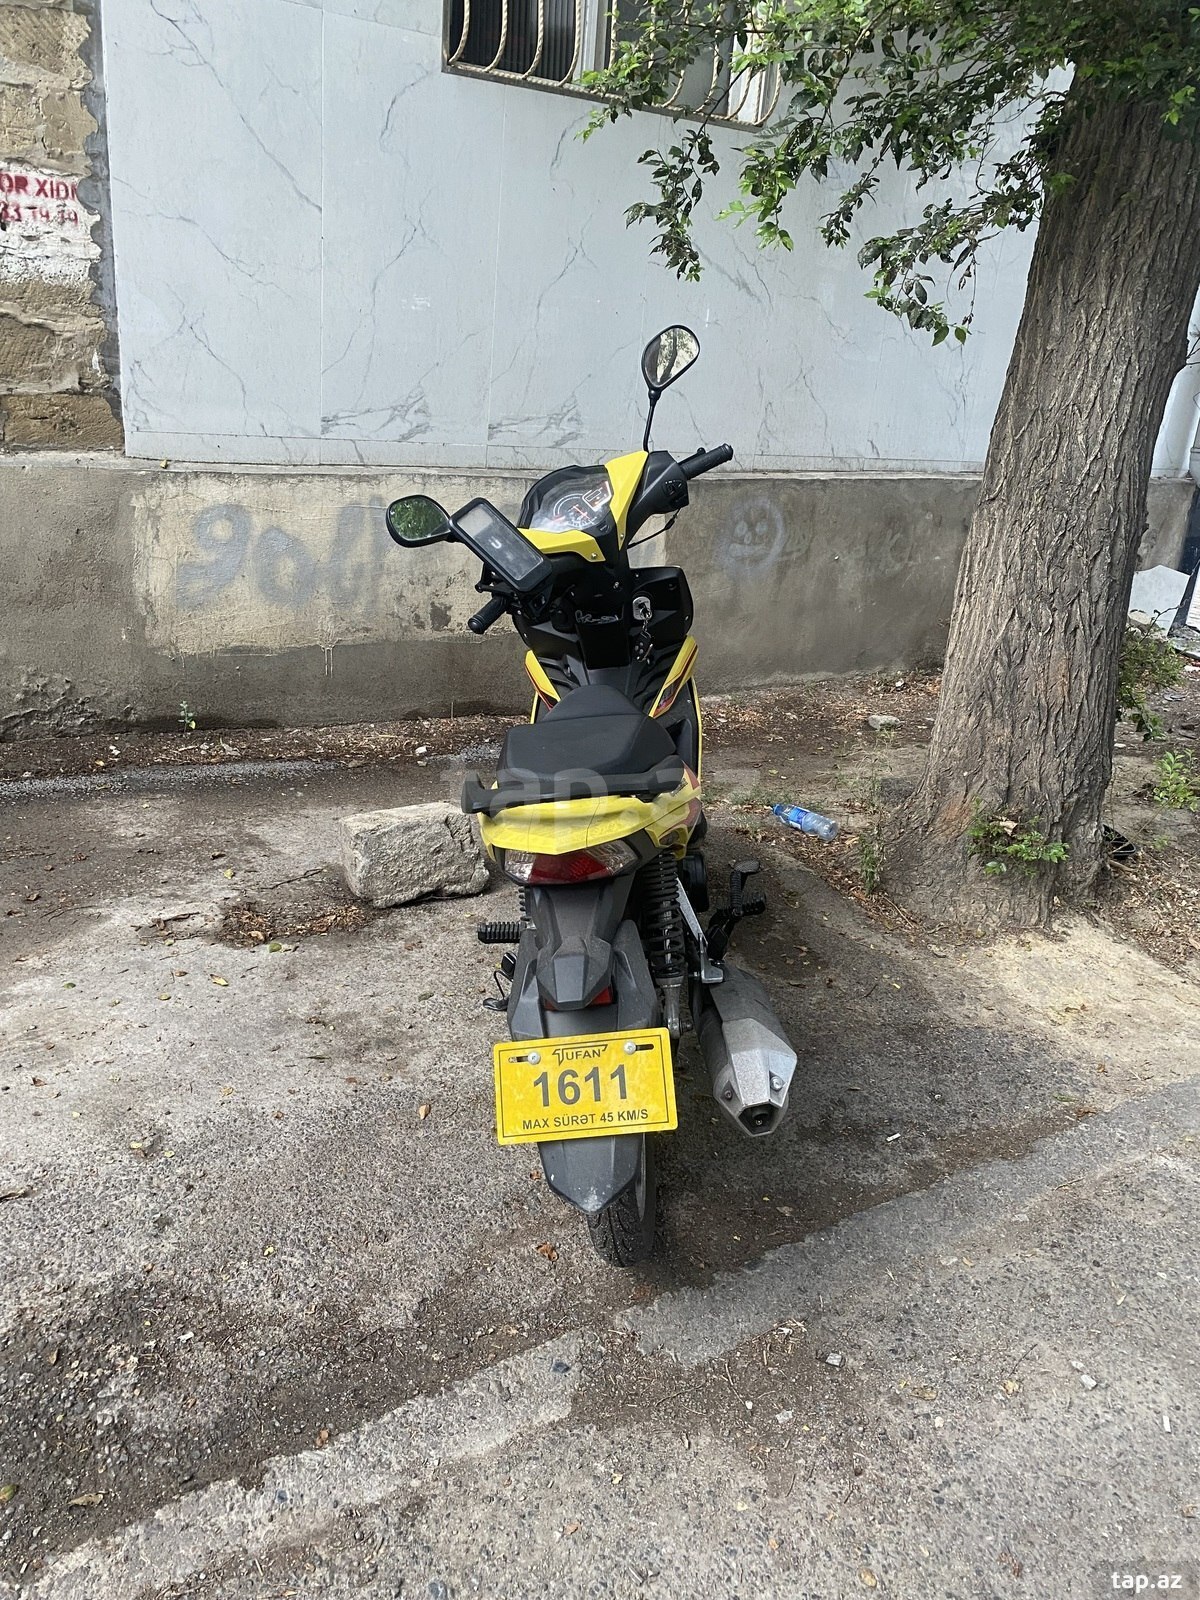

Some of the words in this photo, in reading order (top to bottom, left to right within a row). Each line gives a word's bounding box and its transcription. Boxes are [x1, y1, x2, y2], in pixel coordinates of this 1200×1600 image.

[552, 1044, 608, 1066] TUFAN
[533, 1064, 627, 1107] 1611
[522, 1118, 550, 1130] MAX
[600, 1111, 614, 1123] 45
[617, 1108, 649, 1121] KM/S
